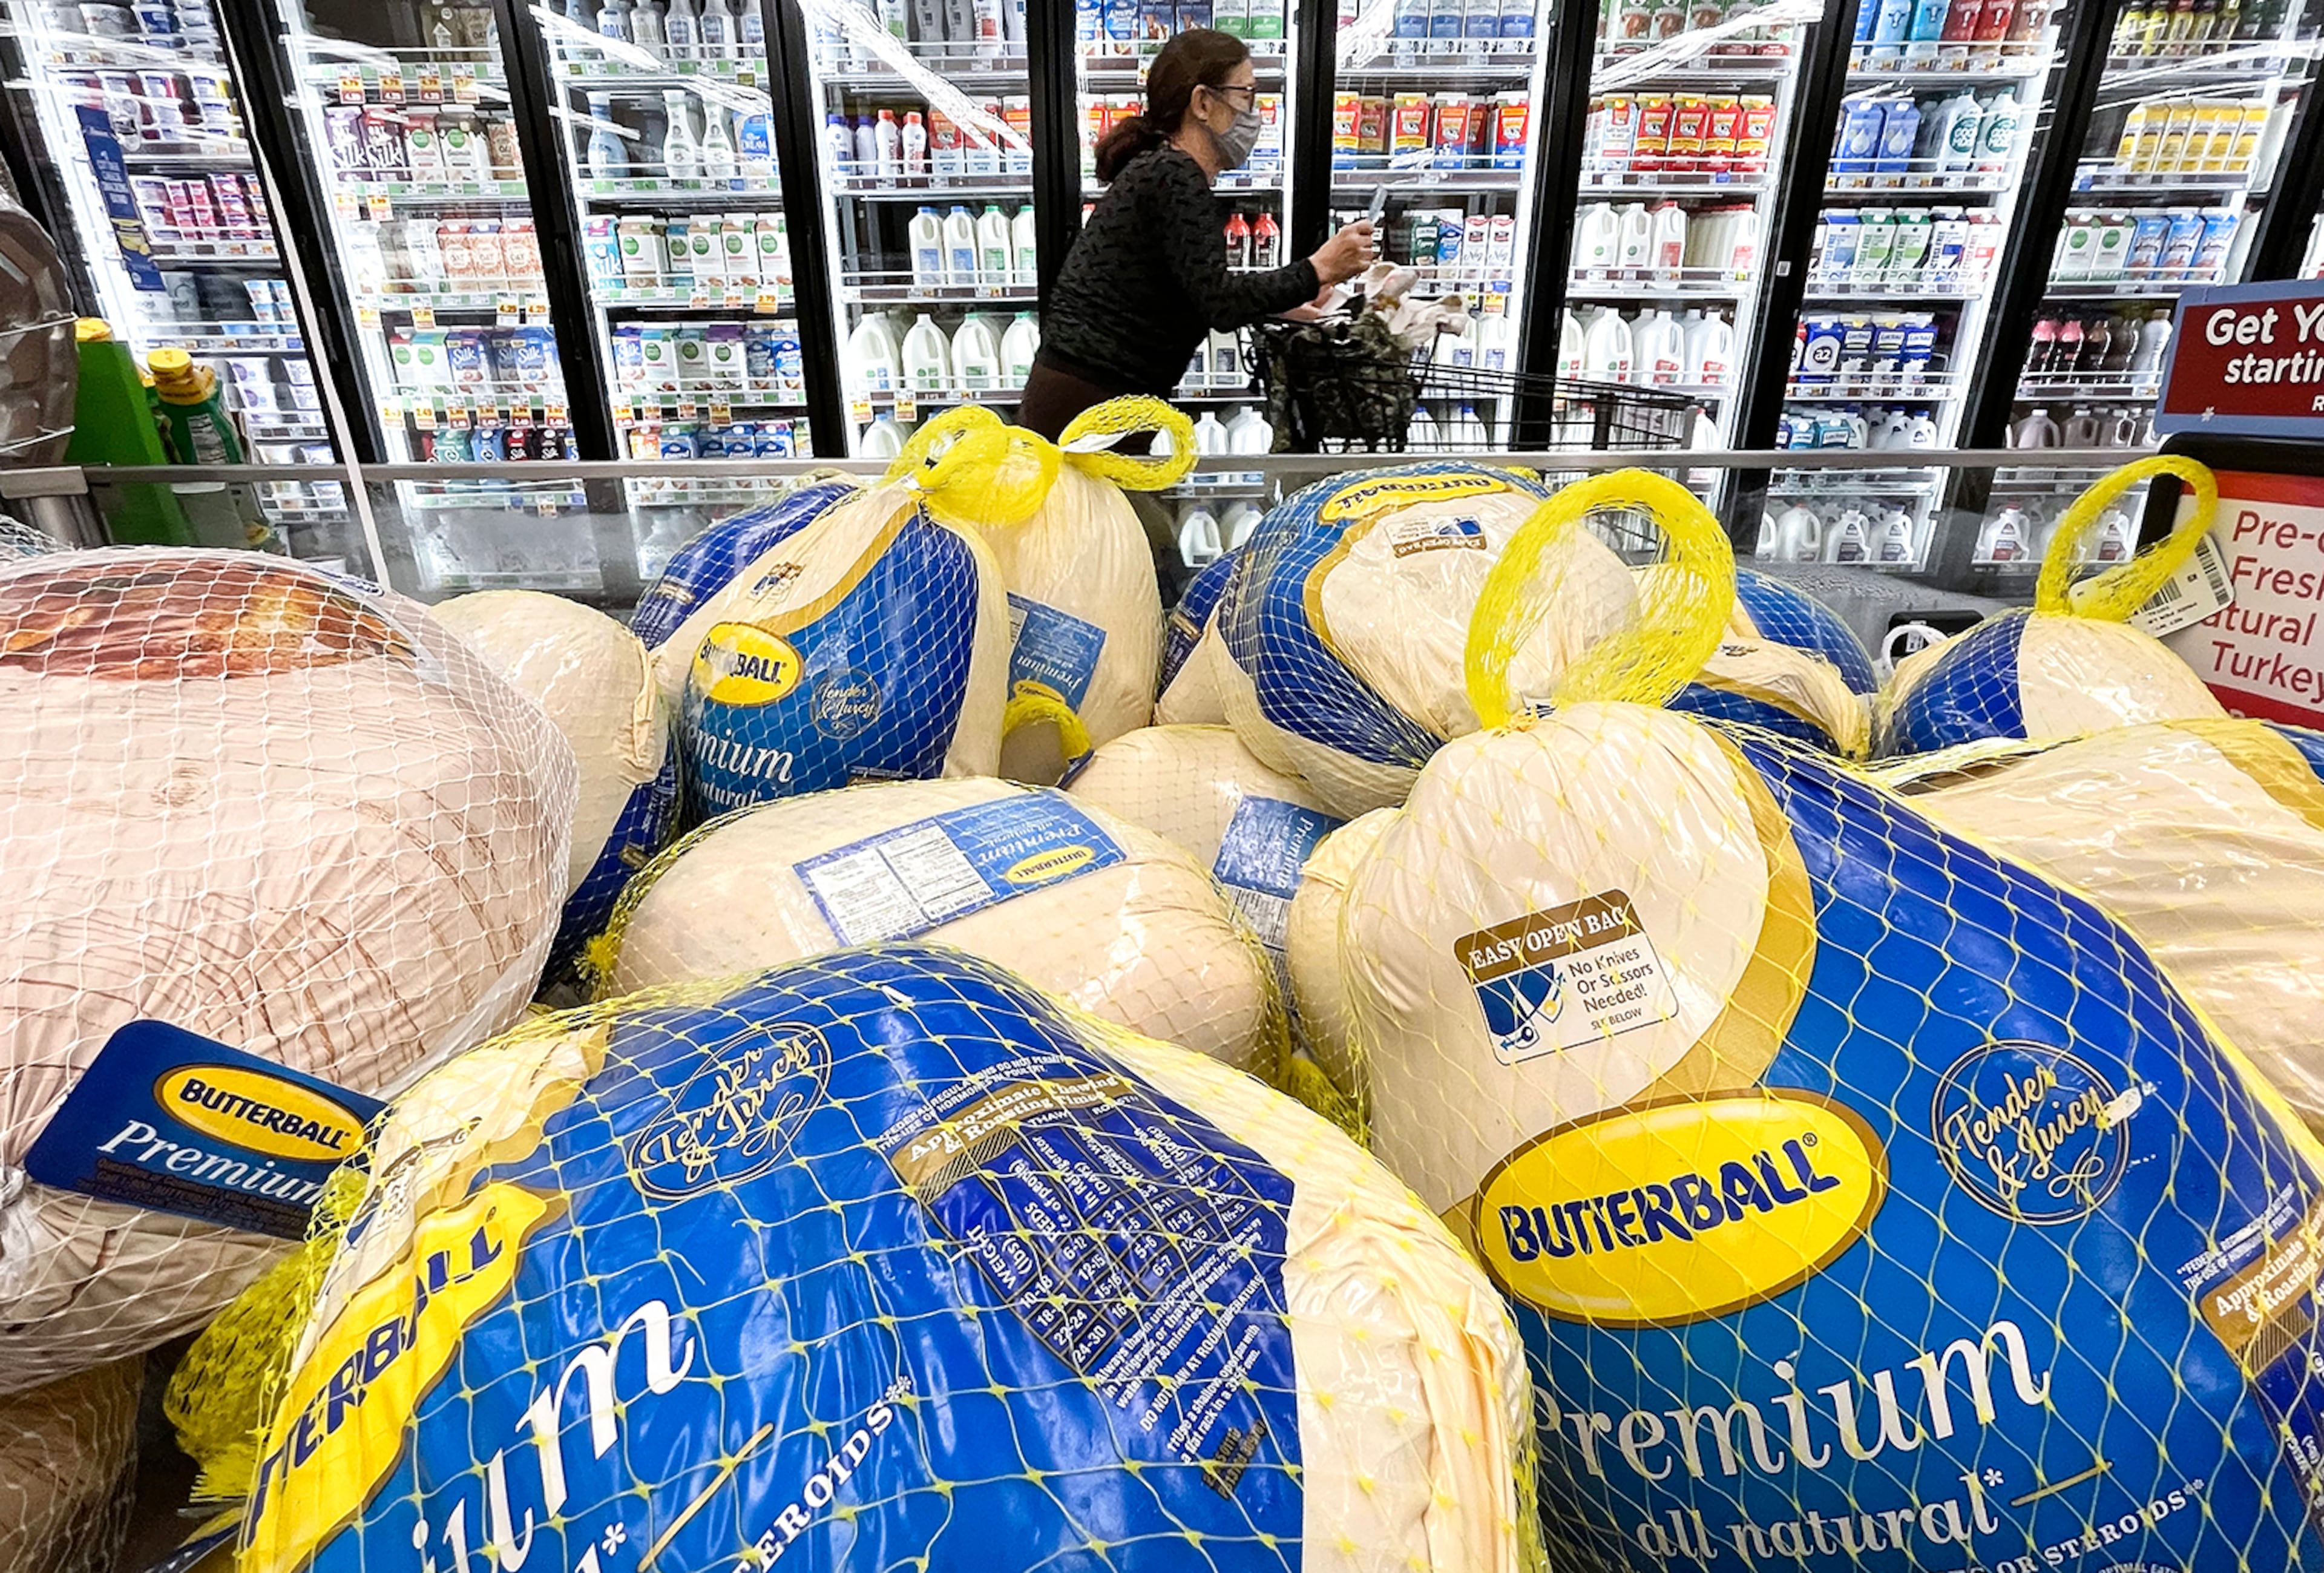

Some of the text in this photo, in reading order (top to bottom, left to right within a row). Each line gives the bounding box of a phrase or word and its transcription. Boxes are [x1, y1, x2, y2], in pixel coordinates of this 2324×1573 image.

[2206, 306, 2279, 346] Get
[453, 346, 476, 364] Silk
[517, 346, 542, 364] Silk
[1815, 348, 1832, 361] a2
[2233, 510, 2324, 555] Pre-
[2201, 605, 2317, 646] atural
[820, 677, 868, 700] Tender
[1017, 655, 1083, 689] Premium
[830, 695, 876, 723] Juicy
[684, 726, 792, 783] emium
[979, 823, 1082, 862] Premium
[1276, 816, 1315, 889] Premium
[1013, 850, 1088, 878] BUTTERBALL
[1468, 936, 1525, 970] EASY
[1525, 922, 1584, 953] OPEN
[1568, 948, 1640, 978] No Knives
[1577, 962, 1654, 995] Or Scssors
[1583, 982, 1648, 1014] Needed!
[1608, 1007, 1643, 1028] BELOW
[639, 1046, 764, 1165] Tender
[717, 1036, 819, 1149] Juicy
[1941, 1063, 2052, 1161] Tender
[180, 1077, 352, 1150] BUTTERBALL
[910, 1086, 1042, 1163] Apoximate
[1074, 1161, 1111, 1195] (DAYS)
[1986, 1144, 2028, 1200] &
[1101, 1200, 1126, 1224] 3-4
[1498, 1131, 1842, 1264] BUTTERBALL®
[1024, 1201, 1061, 1243] FEEDS
[1167, 1209, 1195, 1232] 11-12
[966, 1224, 1017, 1290] WEIGHT
[1001, 1237, 1034, 1275] (lbs)
[1062, 1236, 1088, 1261] 6-12
[1134, 1235, 1158, 1259] 5-6
[1152, 1254, 1173, 1278] 6-7
[1077, 1253, 1107, 1281] 12-15
[2215, 1240, 2305, 1318] Approximate
[2260, 1253, 2319, 1309] Roasting
[1036, 1293, 1069, 1327] 18-
[1071, 1324, 1108, 1364] 24-30
[1094, 1346, 1129, 1387] Always
[1139, 1409, 1160, 1432] DO
[1151, 1388, 1173, 1413] NOT
[1185, 1355, 1203, 1373] AT
[1192, 1375, 1223, 1413] shallow
[1198, 1410, 1219, 1435] rack
[730, 1375, 913, 1573] EROIDS
[1635, 1508, 1719, 1562] all
